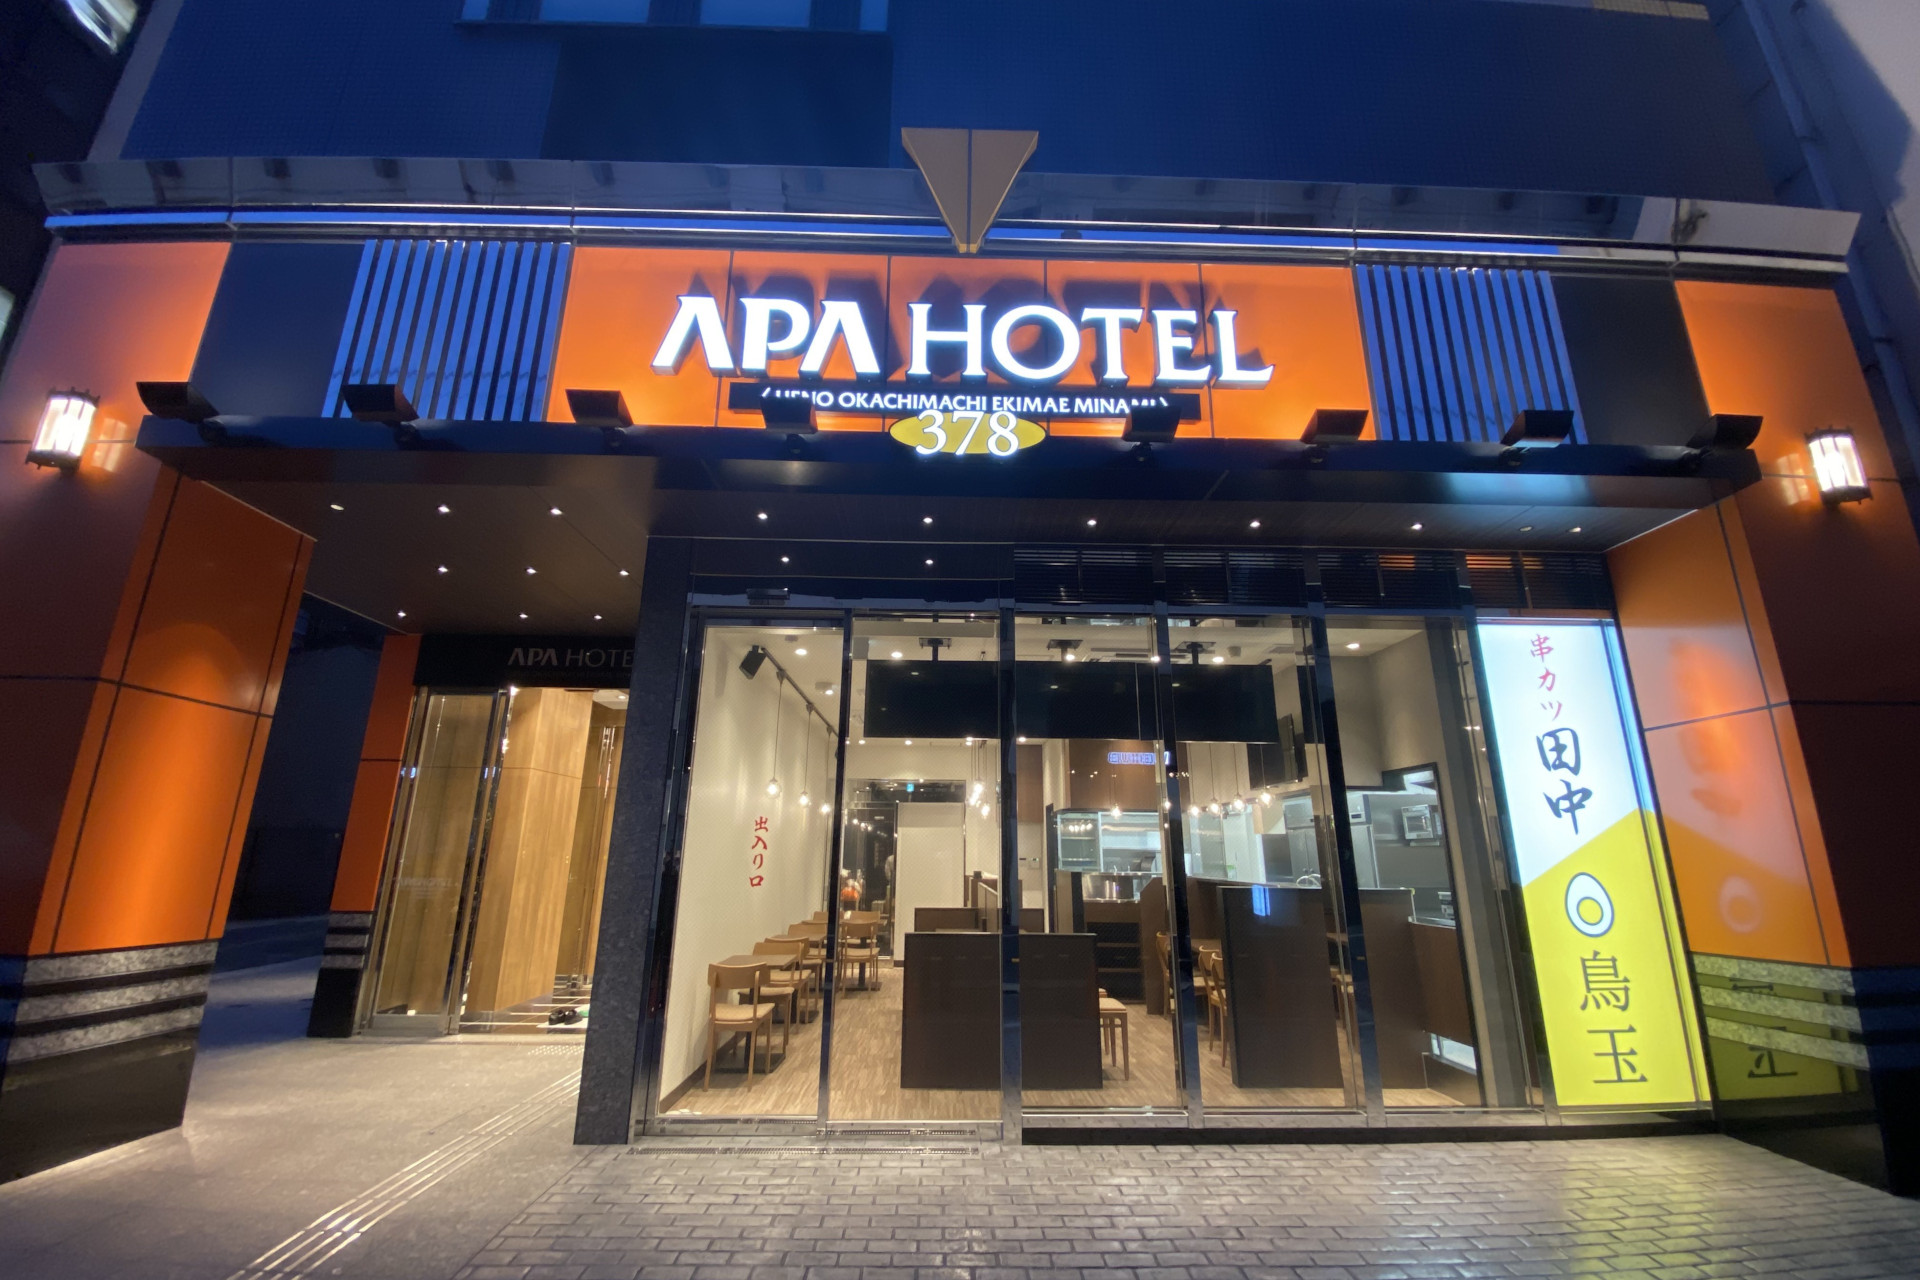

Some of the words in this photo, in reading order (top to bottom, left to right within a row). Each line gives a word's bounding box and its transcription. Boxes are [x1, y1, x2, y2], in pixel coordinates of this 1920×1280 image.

[651, 296, 881, 377] APA
[906, 302, 1275, 388] HOTEL
[838, 392, 987, 411] OKACHIMACHI
[992, 396, 1071, 413] EKIMAE
[915, 410, 1020, 457] 378
[507, 647, 558, 667] APA
[749, 816, 769, 887] 出入り口
[1579, 949, 1648, 1085] 鳥玉
